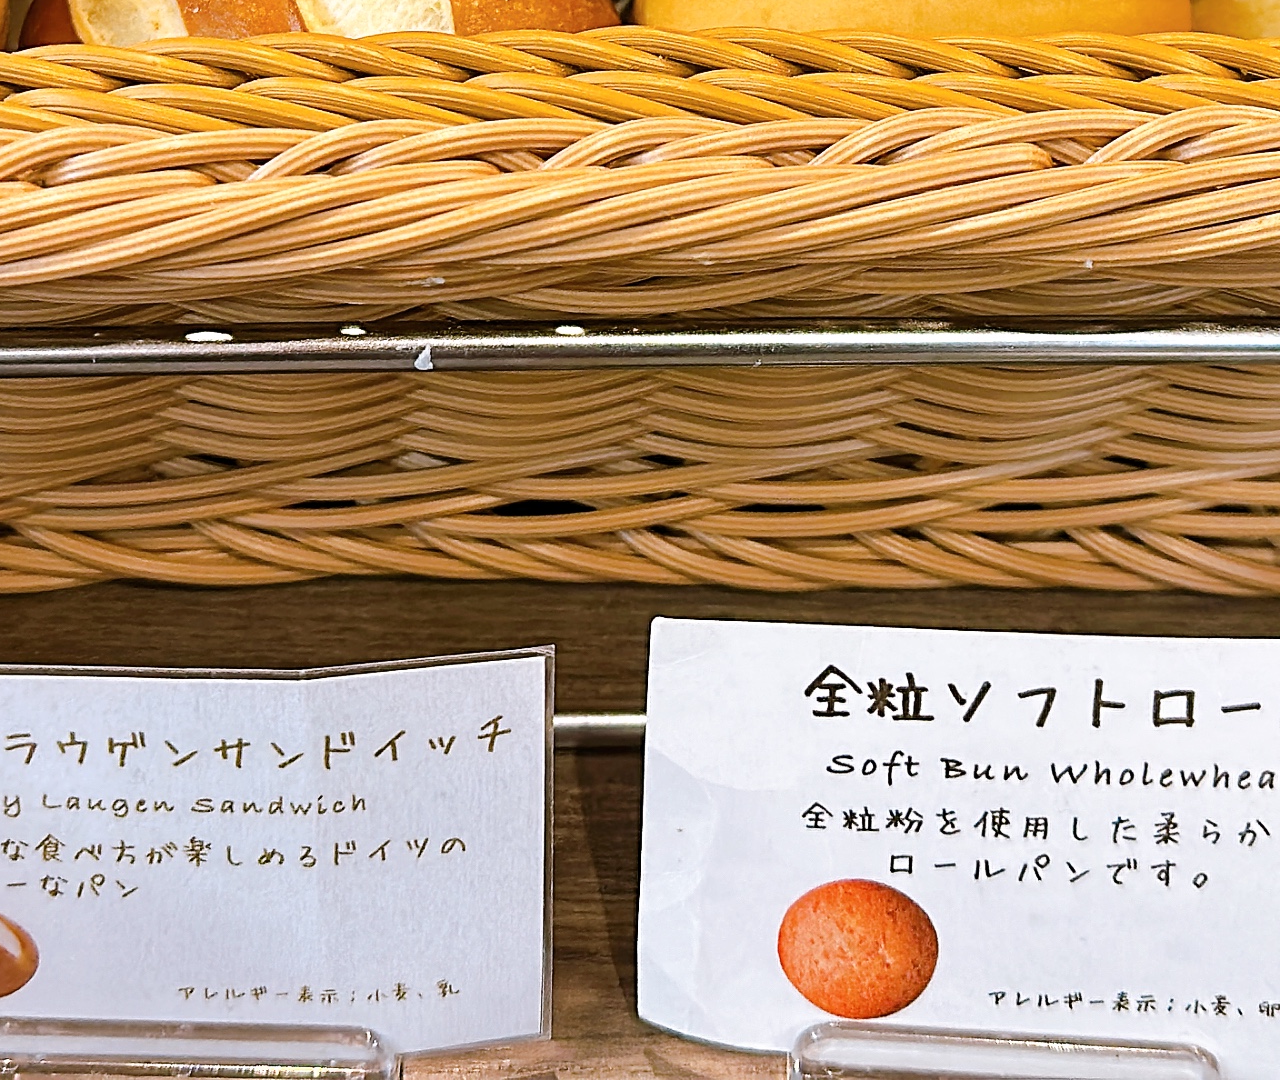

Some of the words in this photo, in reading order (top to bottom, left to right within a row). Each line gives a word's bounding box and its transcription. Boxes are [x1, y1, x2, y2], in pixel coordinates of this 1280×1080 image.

[824, 748, 922, 787] Soft
[938, 756, 1030, 783] Bun
[41, 792, 176, 820] Laugen
[189, 792, 368, 817] Sandwich
